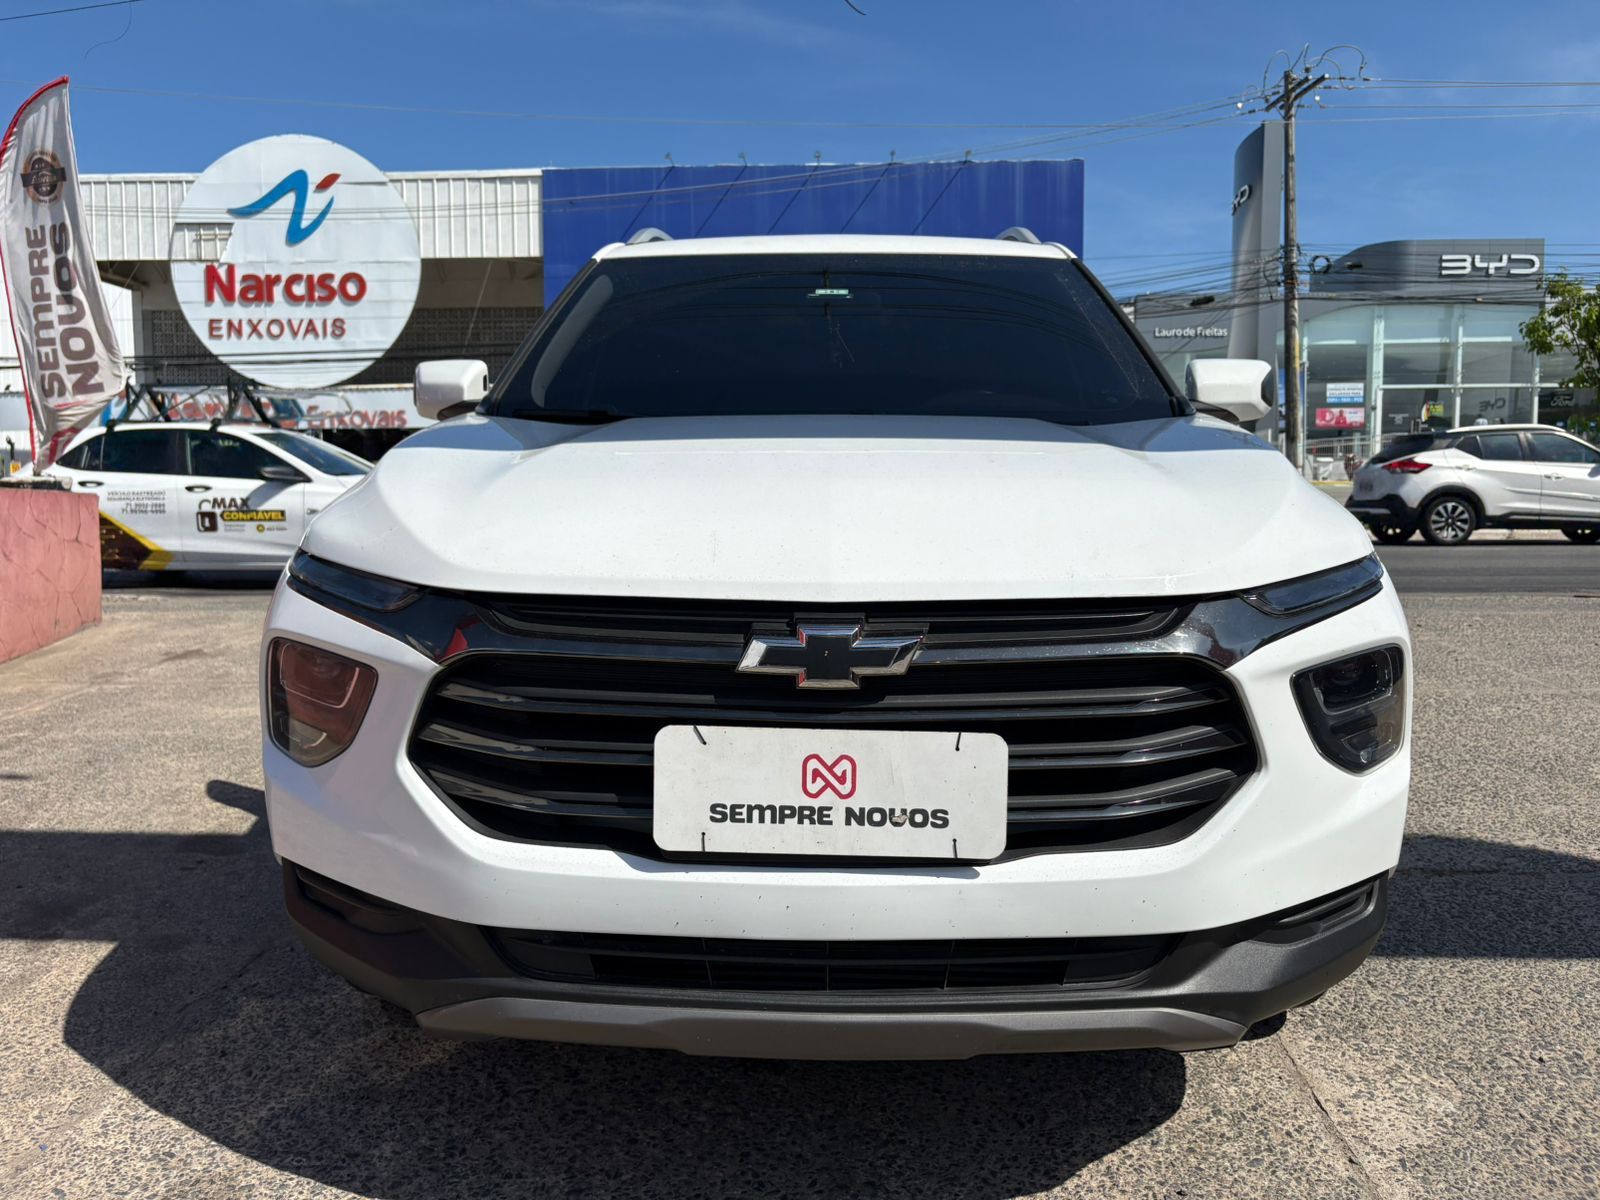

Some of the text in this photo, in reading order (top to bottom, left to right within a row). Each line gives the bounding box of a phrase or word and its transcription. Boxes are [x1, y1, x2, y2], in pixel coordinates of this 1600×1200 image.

[1441, 253, 1541, 275] BYD
[204, 263, 368, 304] Narciso
[25, 223, 67, 398] SEMPRE
[208, 317, 347, 340] ENXOVAIS
[1154, 326, 1228, 337] Lauro de Freitas
[211, 497, 250, 510] MAX
[709, 802, 834, 826] SEMPRE
